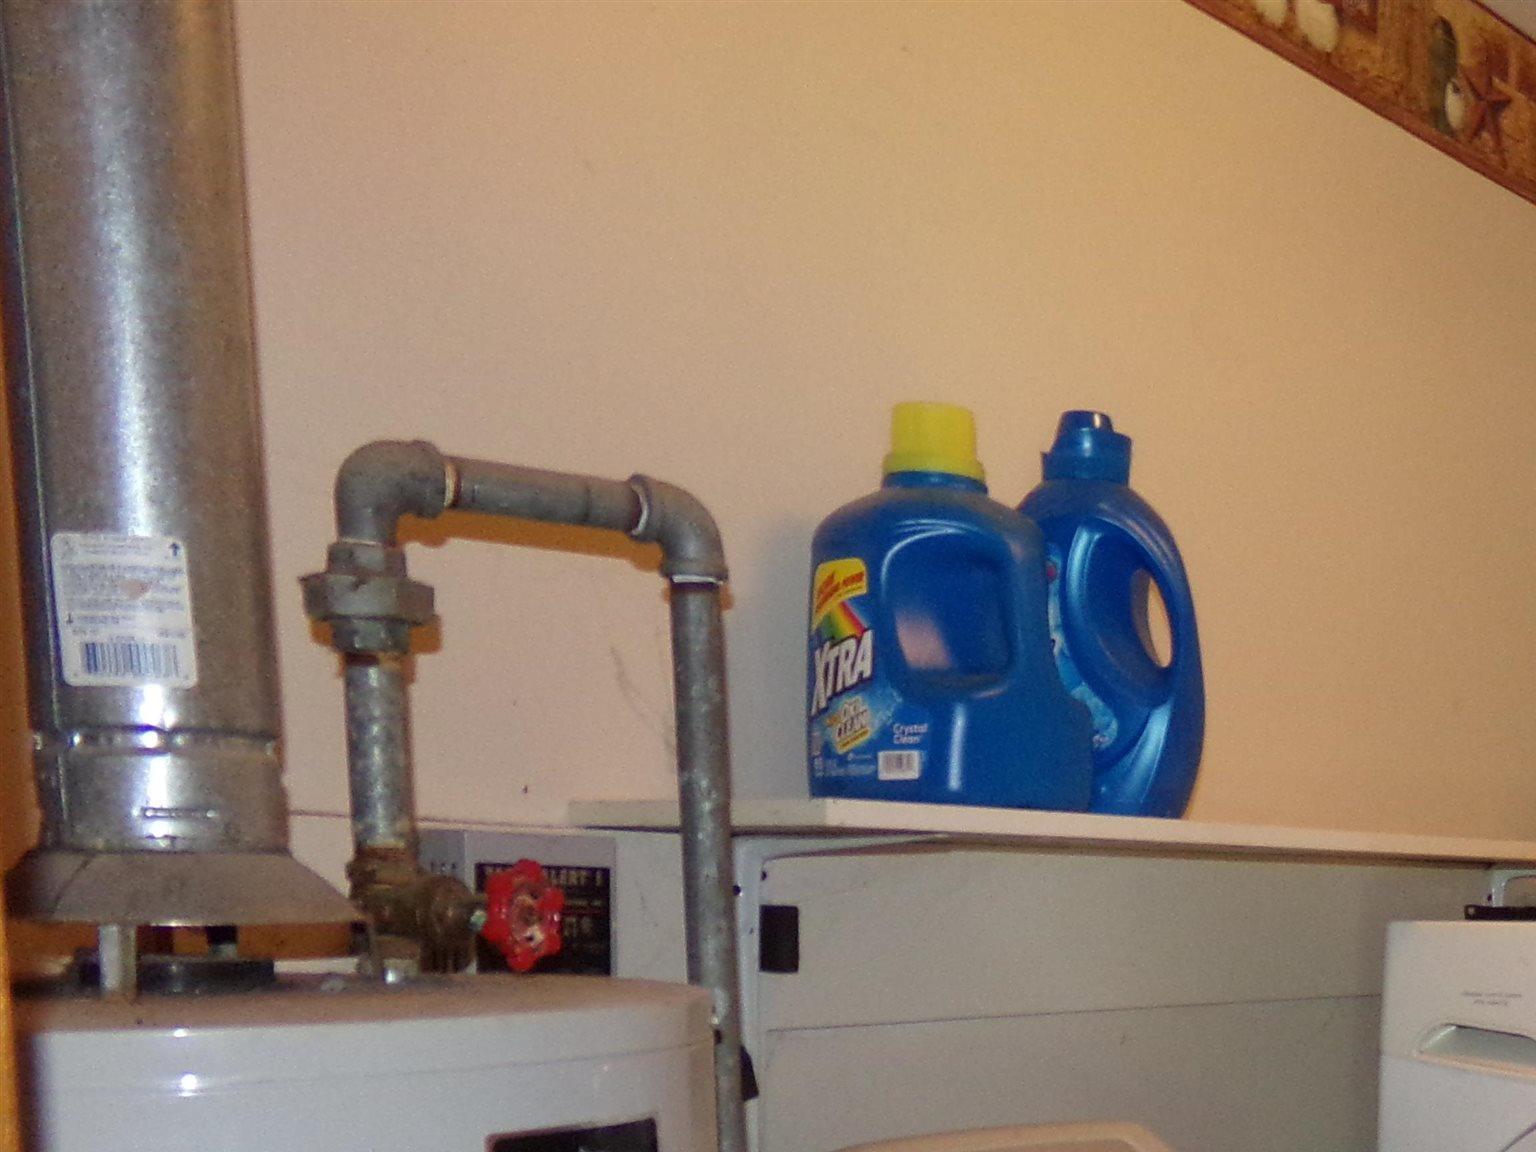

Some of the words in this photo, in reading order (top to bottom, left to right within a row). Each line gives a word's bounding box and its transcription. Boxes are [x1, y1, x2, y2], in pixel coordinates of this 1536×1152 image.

[810, 629, 874, 717] XTRA
[893, 722, 929, 735] Crystal
[893, 734, 922, 745] Clean
